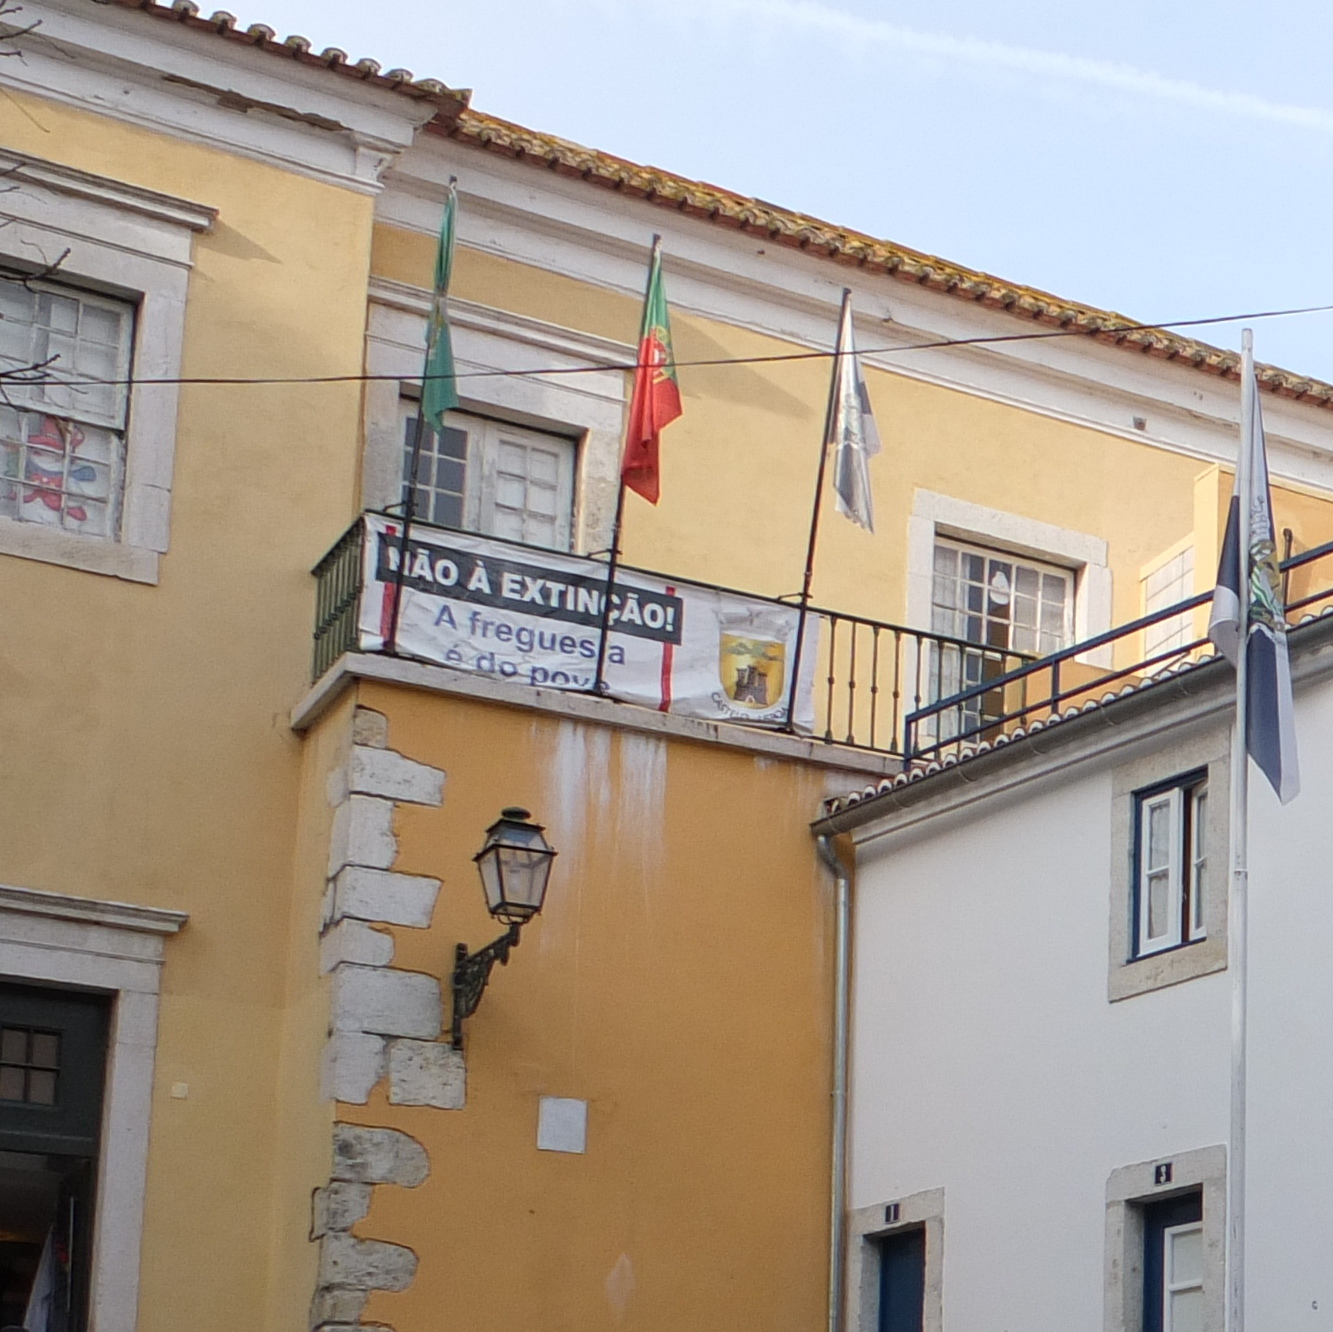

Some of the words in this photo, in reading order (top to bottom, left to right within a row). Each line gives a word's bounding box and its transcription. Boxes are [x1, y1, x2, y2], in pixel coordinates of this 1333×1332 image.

[467, 560, 492, 595] À
[434, 605, 457, 630] A
[470, 611, 625, 665] freguesa
[476, 652, 517, 677] do
